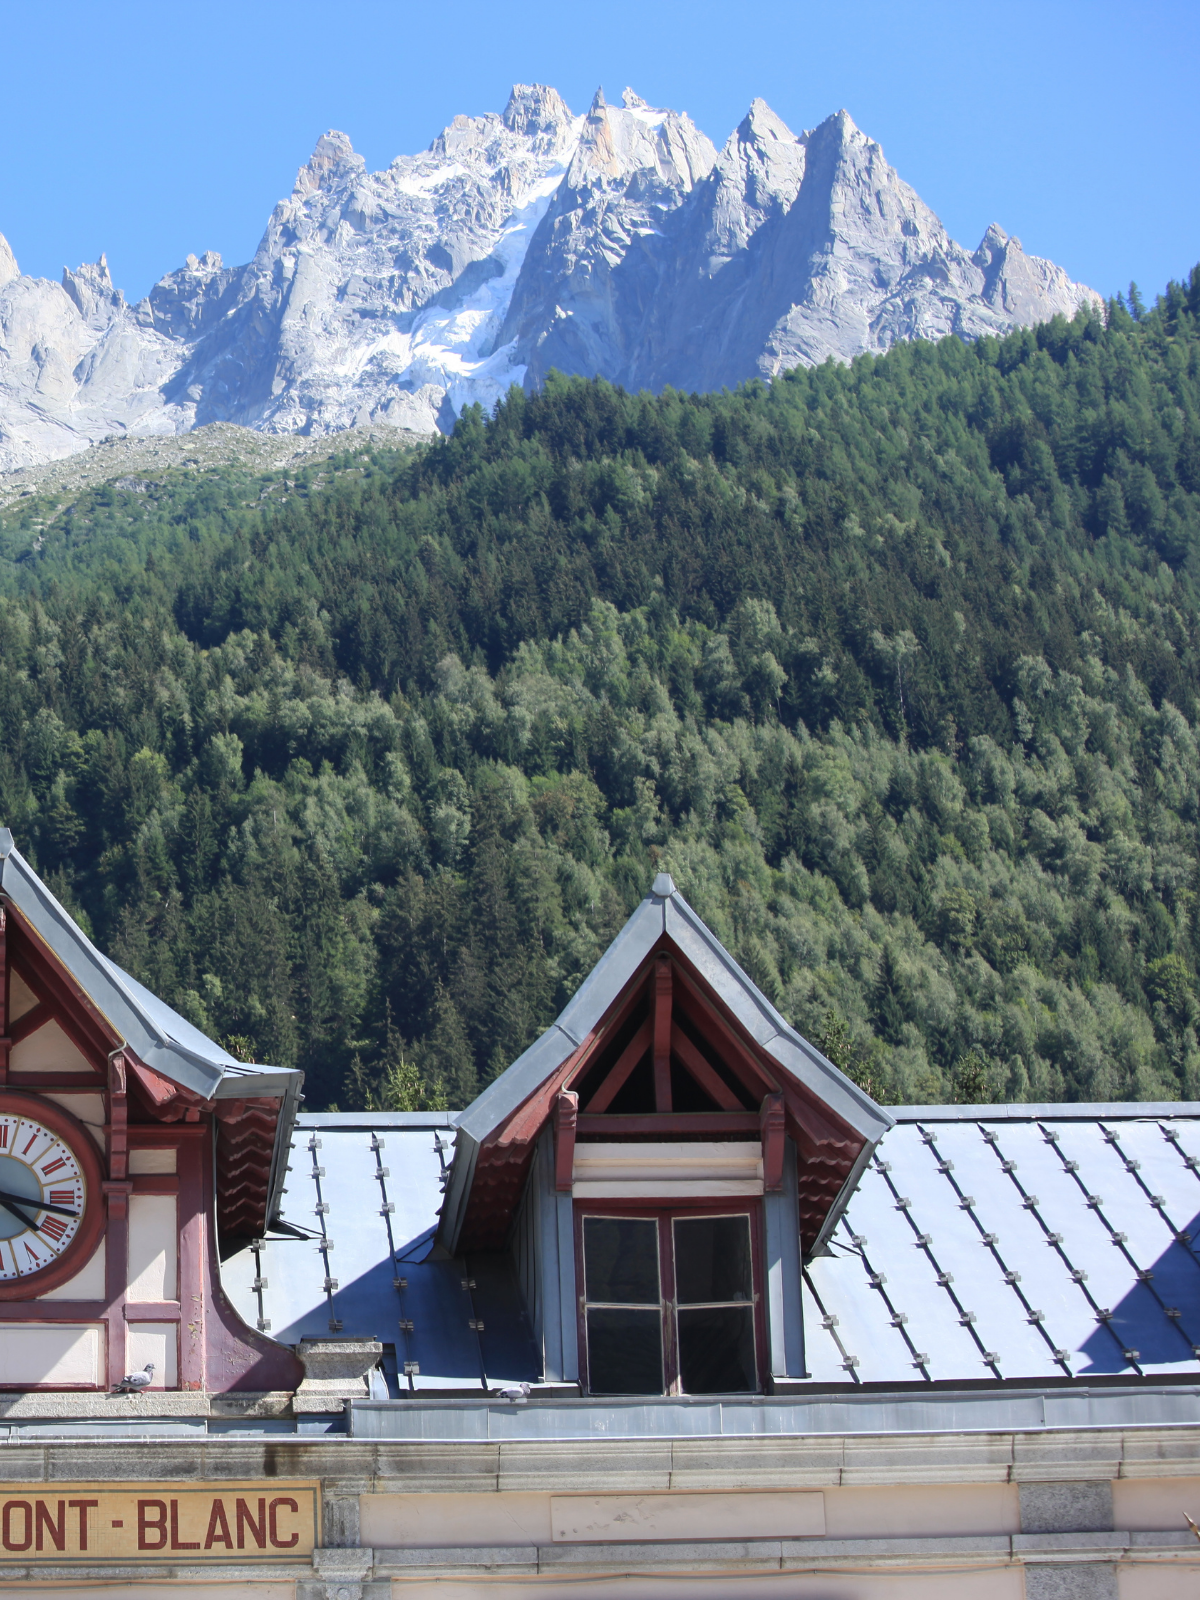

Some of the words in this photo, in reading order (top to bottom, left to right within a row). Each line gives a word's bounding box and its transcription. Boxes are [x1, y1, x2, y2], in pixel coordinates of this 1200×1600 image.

[21, 1133, 39, 1156] I
[41, 1156, 67, 1177] II
[50, 1190, 75, 1205] III
[39, 1214, 69, 1243] IIII
[23, 1241, 40, 1264] V
[138, 1497, 299, 1550] BLANC
